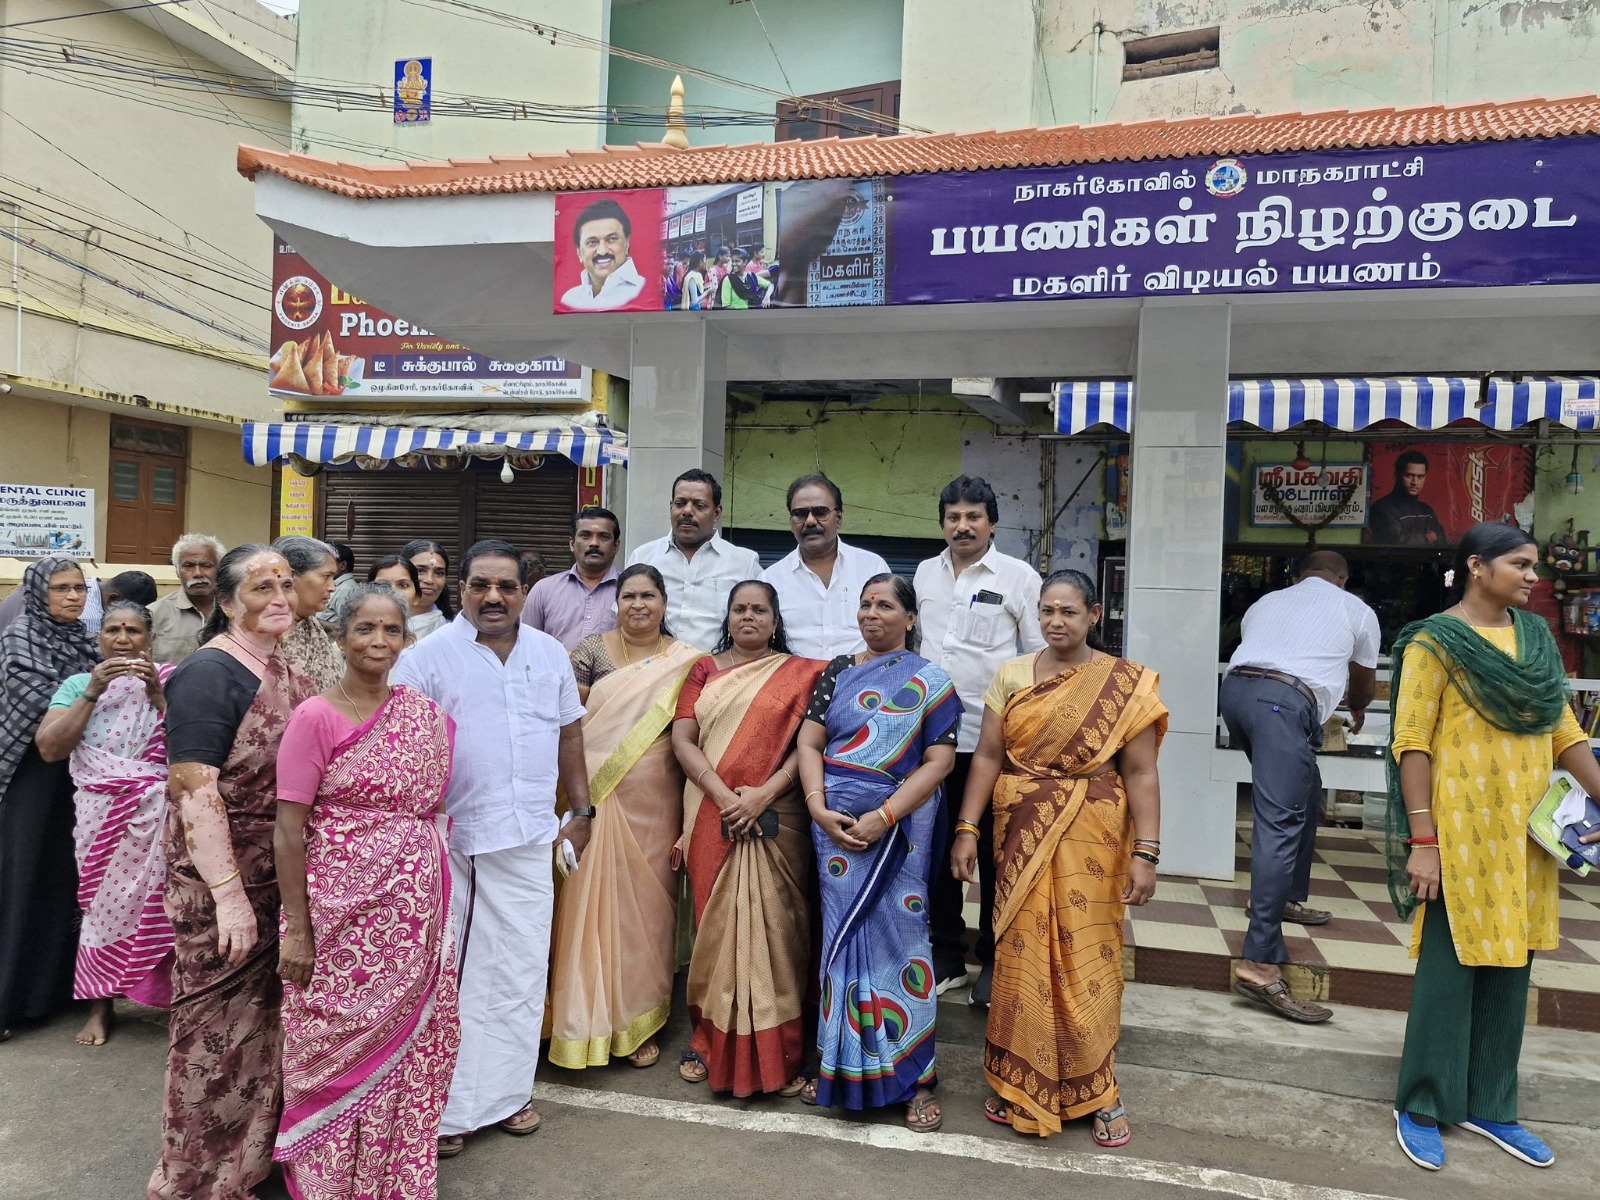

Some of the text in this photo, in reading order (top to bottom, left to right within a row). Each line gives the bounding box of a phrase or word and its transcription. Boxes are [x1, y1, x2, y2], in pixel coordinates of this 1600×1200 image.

[1013, 157, 1425, 203] நாகர்கோவில் மாநகராட்சி
[873, 184, 882, 192] 31
[873, 195, 883, 204] 30
[873, 216, 883, 224] 28
[929, 196, 1217, 256] பயணிகள்
[1234, 188, 1579, 254] நிழற்குடை
[837, 226, 865, 238] ாநகர்
[873, 226, 883, 234] 27
[873, 237, 884, 245] 26
[873, 247, 884, 255] 25
[873, 258, 884, 266] 24
[822, 257, 871, 278] மகளிர்
[873, 268, 884, 276] 23
[1011, 252, 1441, 297] மகளிர் விடியல் பயணம்
[810, 273, 820, 281] 10
[873, 279, 884, 287] 22
[873, 289, 883, 298] 21
[810, 294, 820, 302] 12
[339, 311, 436, 337] Phoe
[374, 361, 386, 372] டீ
[401, 355, 477, 373] சுக்குபால்
[45, 488, 87, 498] CLINIC
